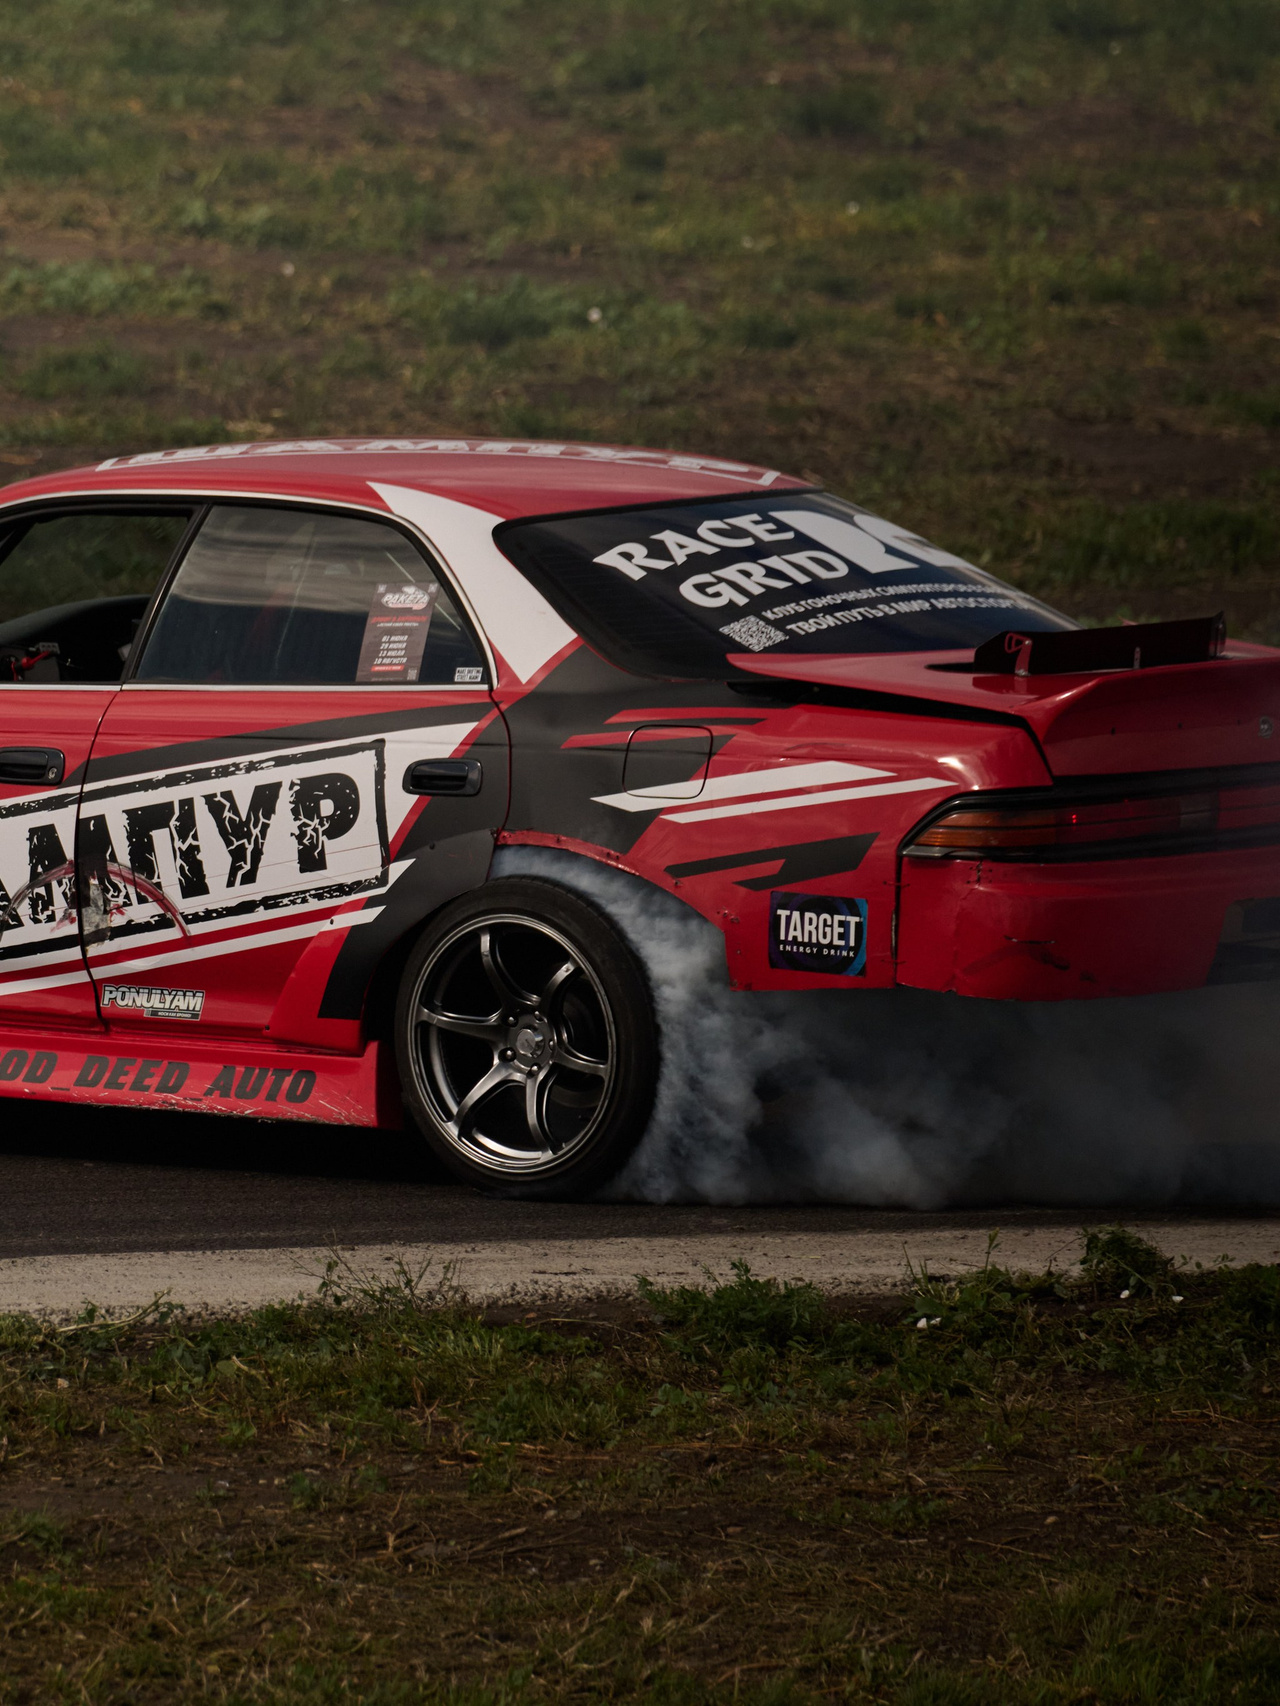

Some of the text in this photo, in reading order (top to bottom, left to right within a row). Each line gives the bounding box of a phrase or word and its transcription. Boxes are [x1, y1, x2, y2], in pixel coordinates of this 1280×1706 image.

[592, 513, 796, 581] RACE
[383, 592, 429, 605] РАКЕТА
[762, 602, 805, 621] КЛУБ
[800, 587, 881, 611] ГОНОЧНЫХ
[786, 613, 842, 636] ТВОЙ
[833, 605, 884, 624] ПУТЬ
[876, 603, 897, 616] В
[891, 599, 932, 614] МИР
[776, 909, 860, 947] TARGET
[779, 944, 855, 957] ENERGY DRINK
[101, 985, 205, 1012] PONULYAM
